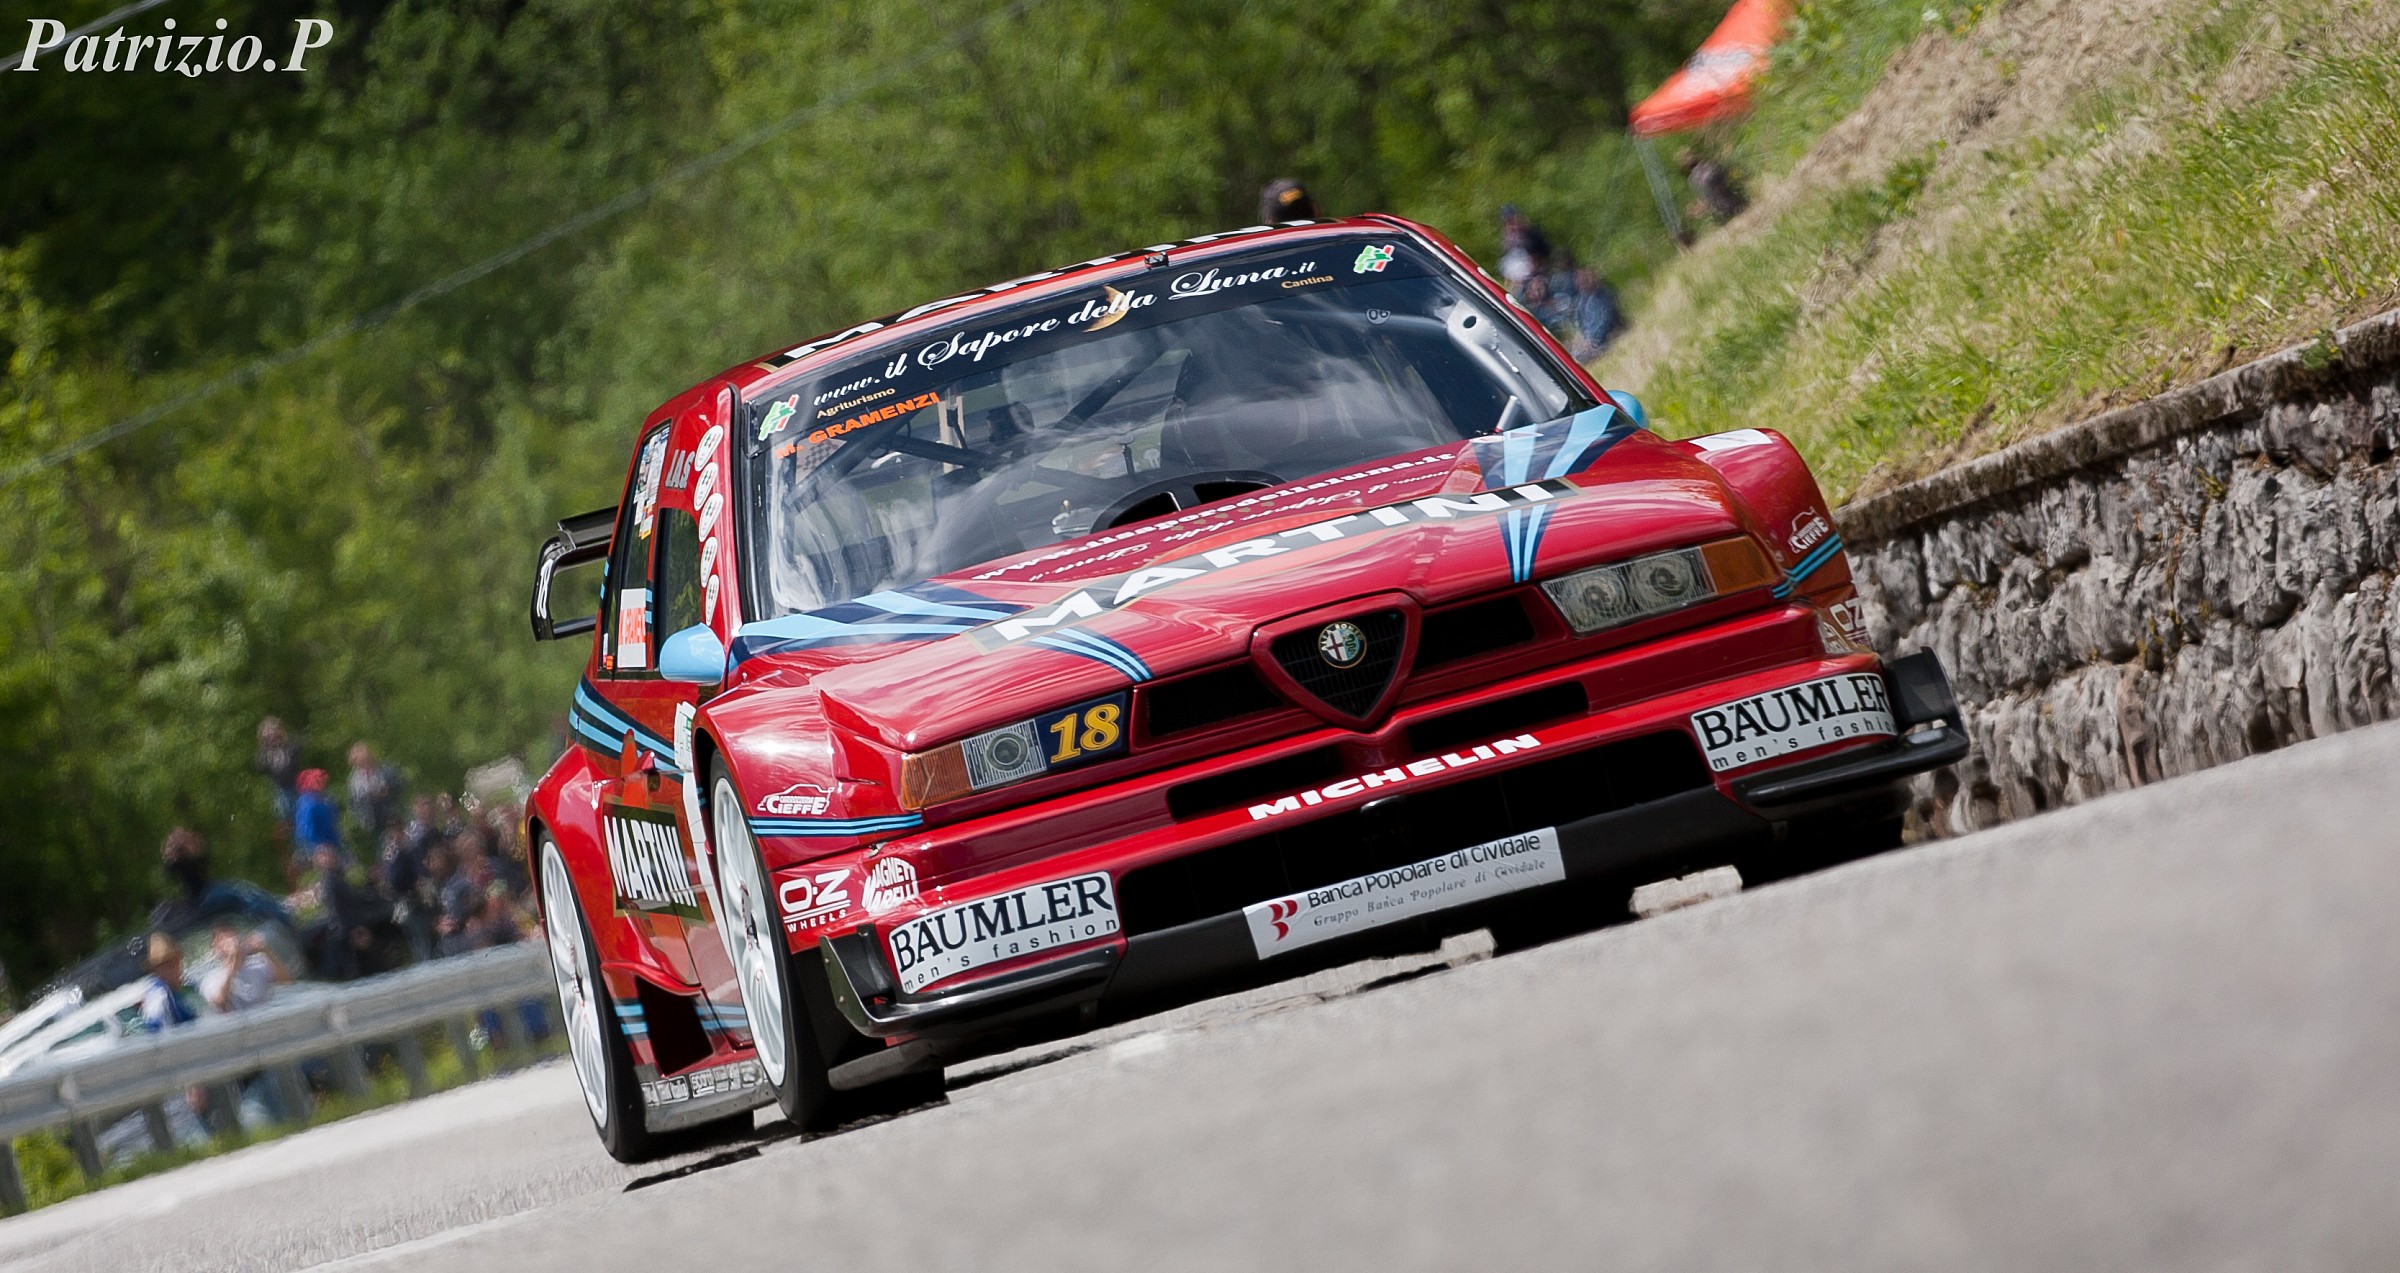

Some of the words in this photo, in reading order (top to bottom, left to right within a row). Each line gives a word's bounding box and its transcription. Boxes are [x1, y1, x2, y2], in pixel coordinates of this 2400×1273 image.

[1281, 275, 1334, 289] Cantina
[917, 317, 1061, 371] Sapore
[1068, 290, 1157, 325] della
[808, 392, 940, 444] GRAMENZI
[817, 387, 896, 419] Agriturismo
[993, 483, 1554, 641] MARTINI
[1050, 703, 1120, 763] 18
[766, 795, 827, 815] CIEFFE
[1248, 734, 1541, 820] MICHELIN
[604, 815, 697, 907] MARTINI
[1307, 880, 1363, 908] Banca
[1365, 857, 1446, 893] Popolare
[1450, 850, 1468, 870] di
[1470, 835, 1541, 864] Cividale
[787, 909, 847, 933] WHEELS
[891, 876, 1113, 973] BÄUMLER
[1313, 908, 1359, 927] Gruppo
[1409, 878, 1467, 901] Popolare
[1475, 869, 1487, 884] di
[993, 917, 1118, 958] fashion
